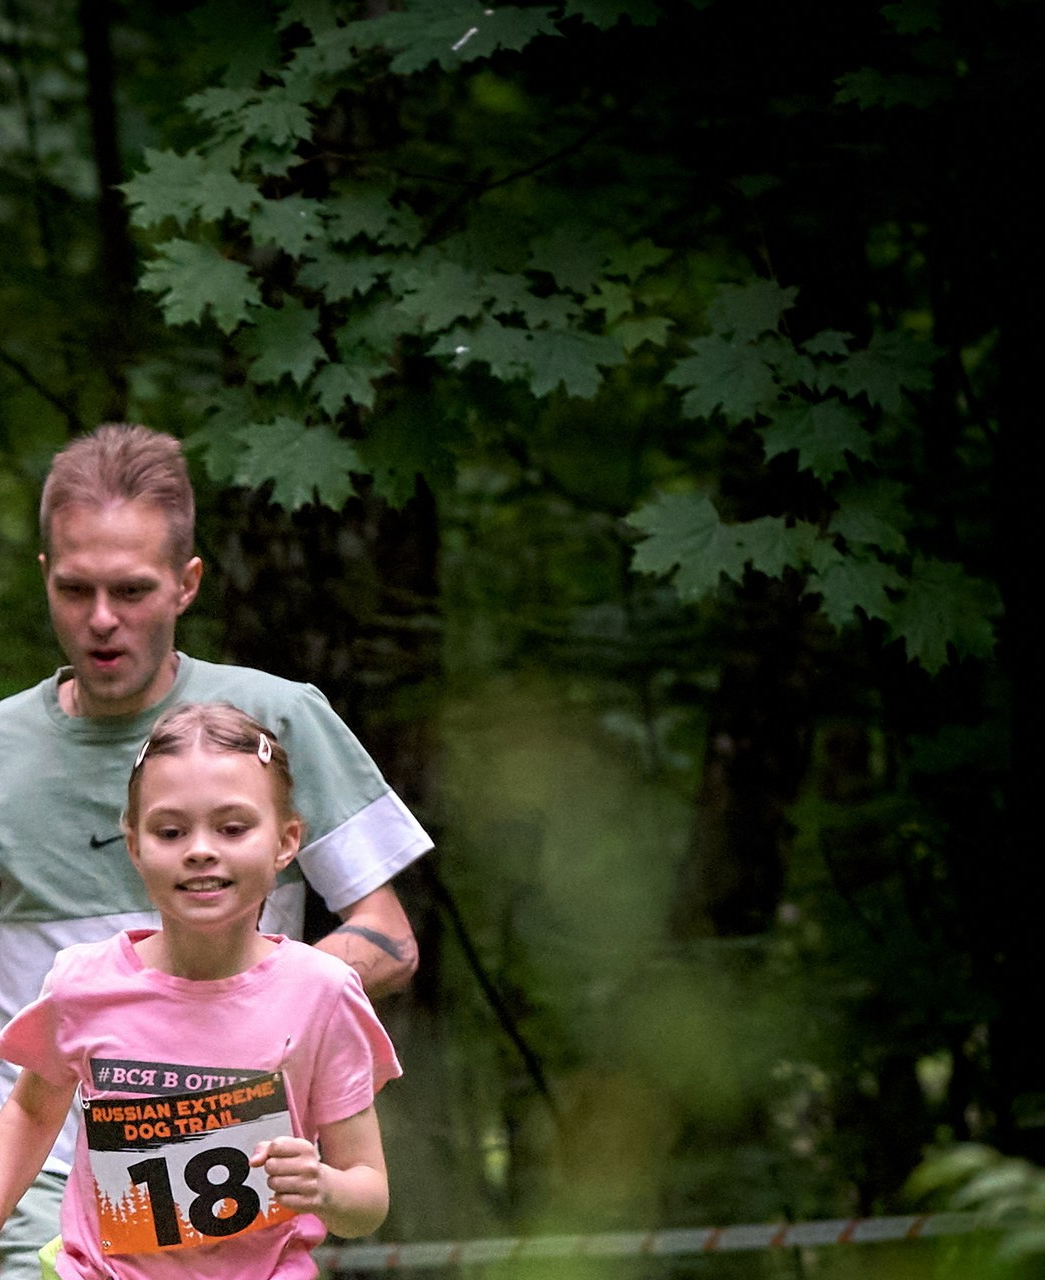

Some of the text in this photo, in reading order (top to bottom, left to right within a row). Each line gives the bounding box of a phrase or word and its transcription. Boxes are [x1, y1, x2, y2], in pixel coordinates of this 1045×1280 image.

[98, 1067, 157, 1086] #ВСЯ
[162, 1071, 178, 1088] В
[92, 1080, 275, 1122] RUSSIAN EXTREME
[124, 1110, 241, 1141] DOG TRAIL
[127, 1147, 261, 1247] 18
